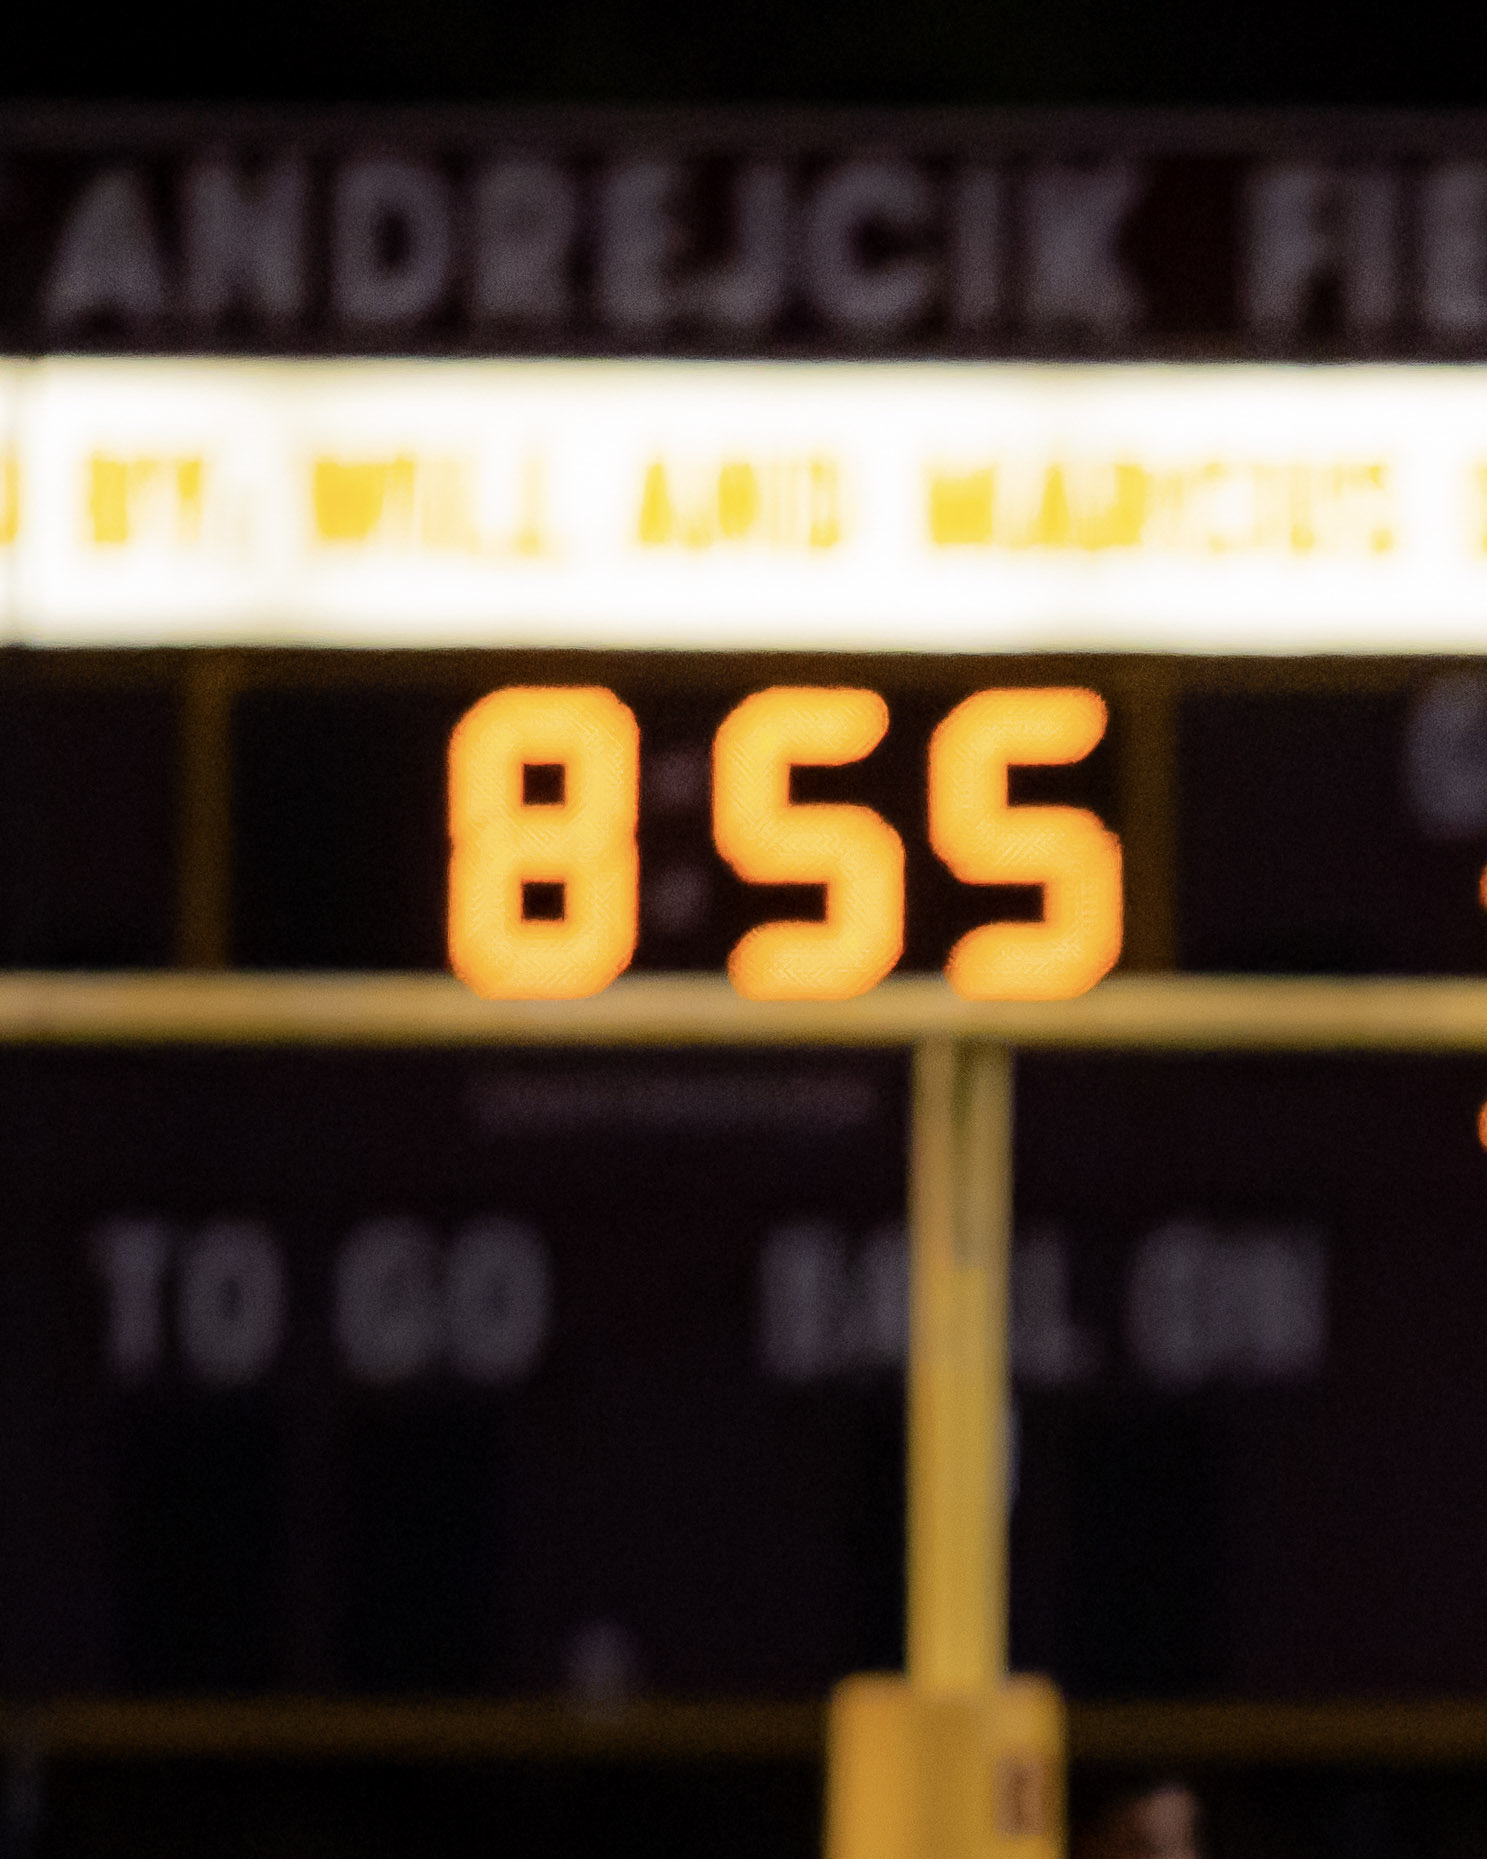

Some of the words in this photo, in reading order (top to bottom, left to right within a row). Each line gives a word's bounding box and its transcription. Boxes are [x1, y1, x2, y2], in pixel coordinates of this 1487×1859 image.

[40, 152, 1146, 330] ANDREJCIK
[94, 1218, 286, 1384] TO
[334, 1216, 554, 1384] GO
